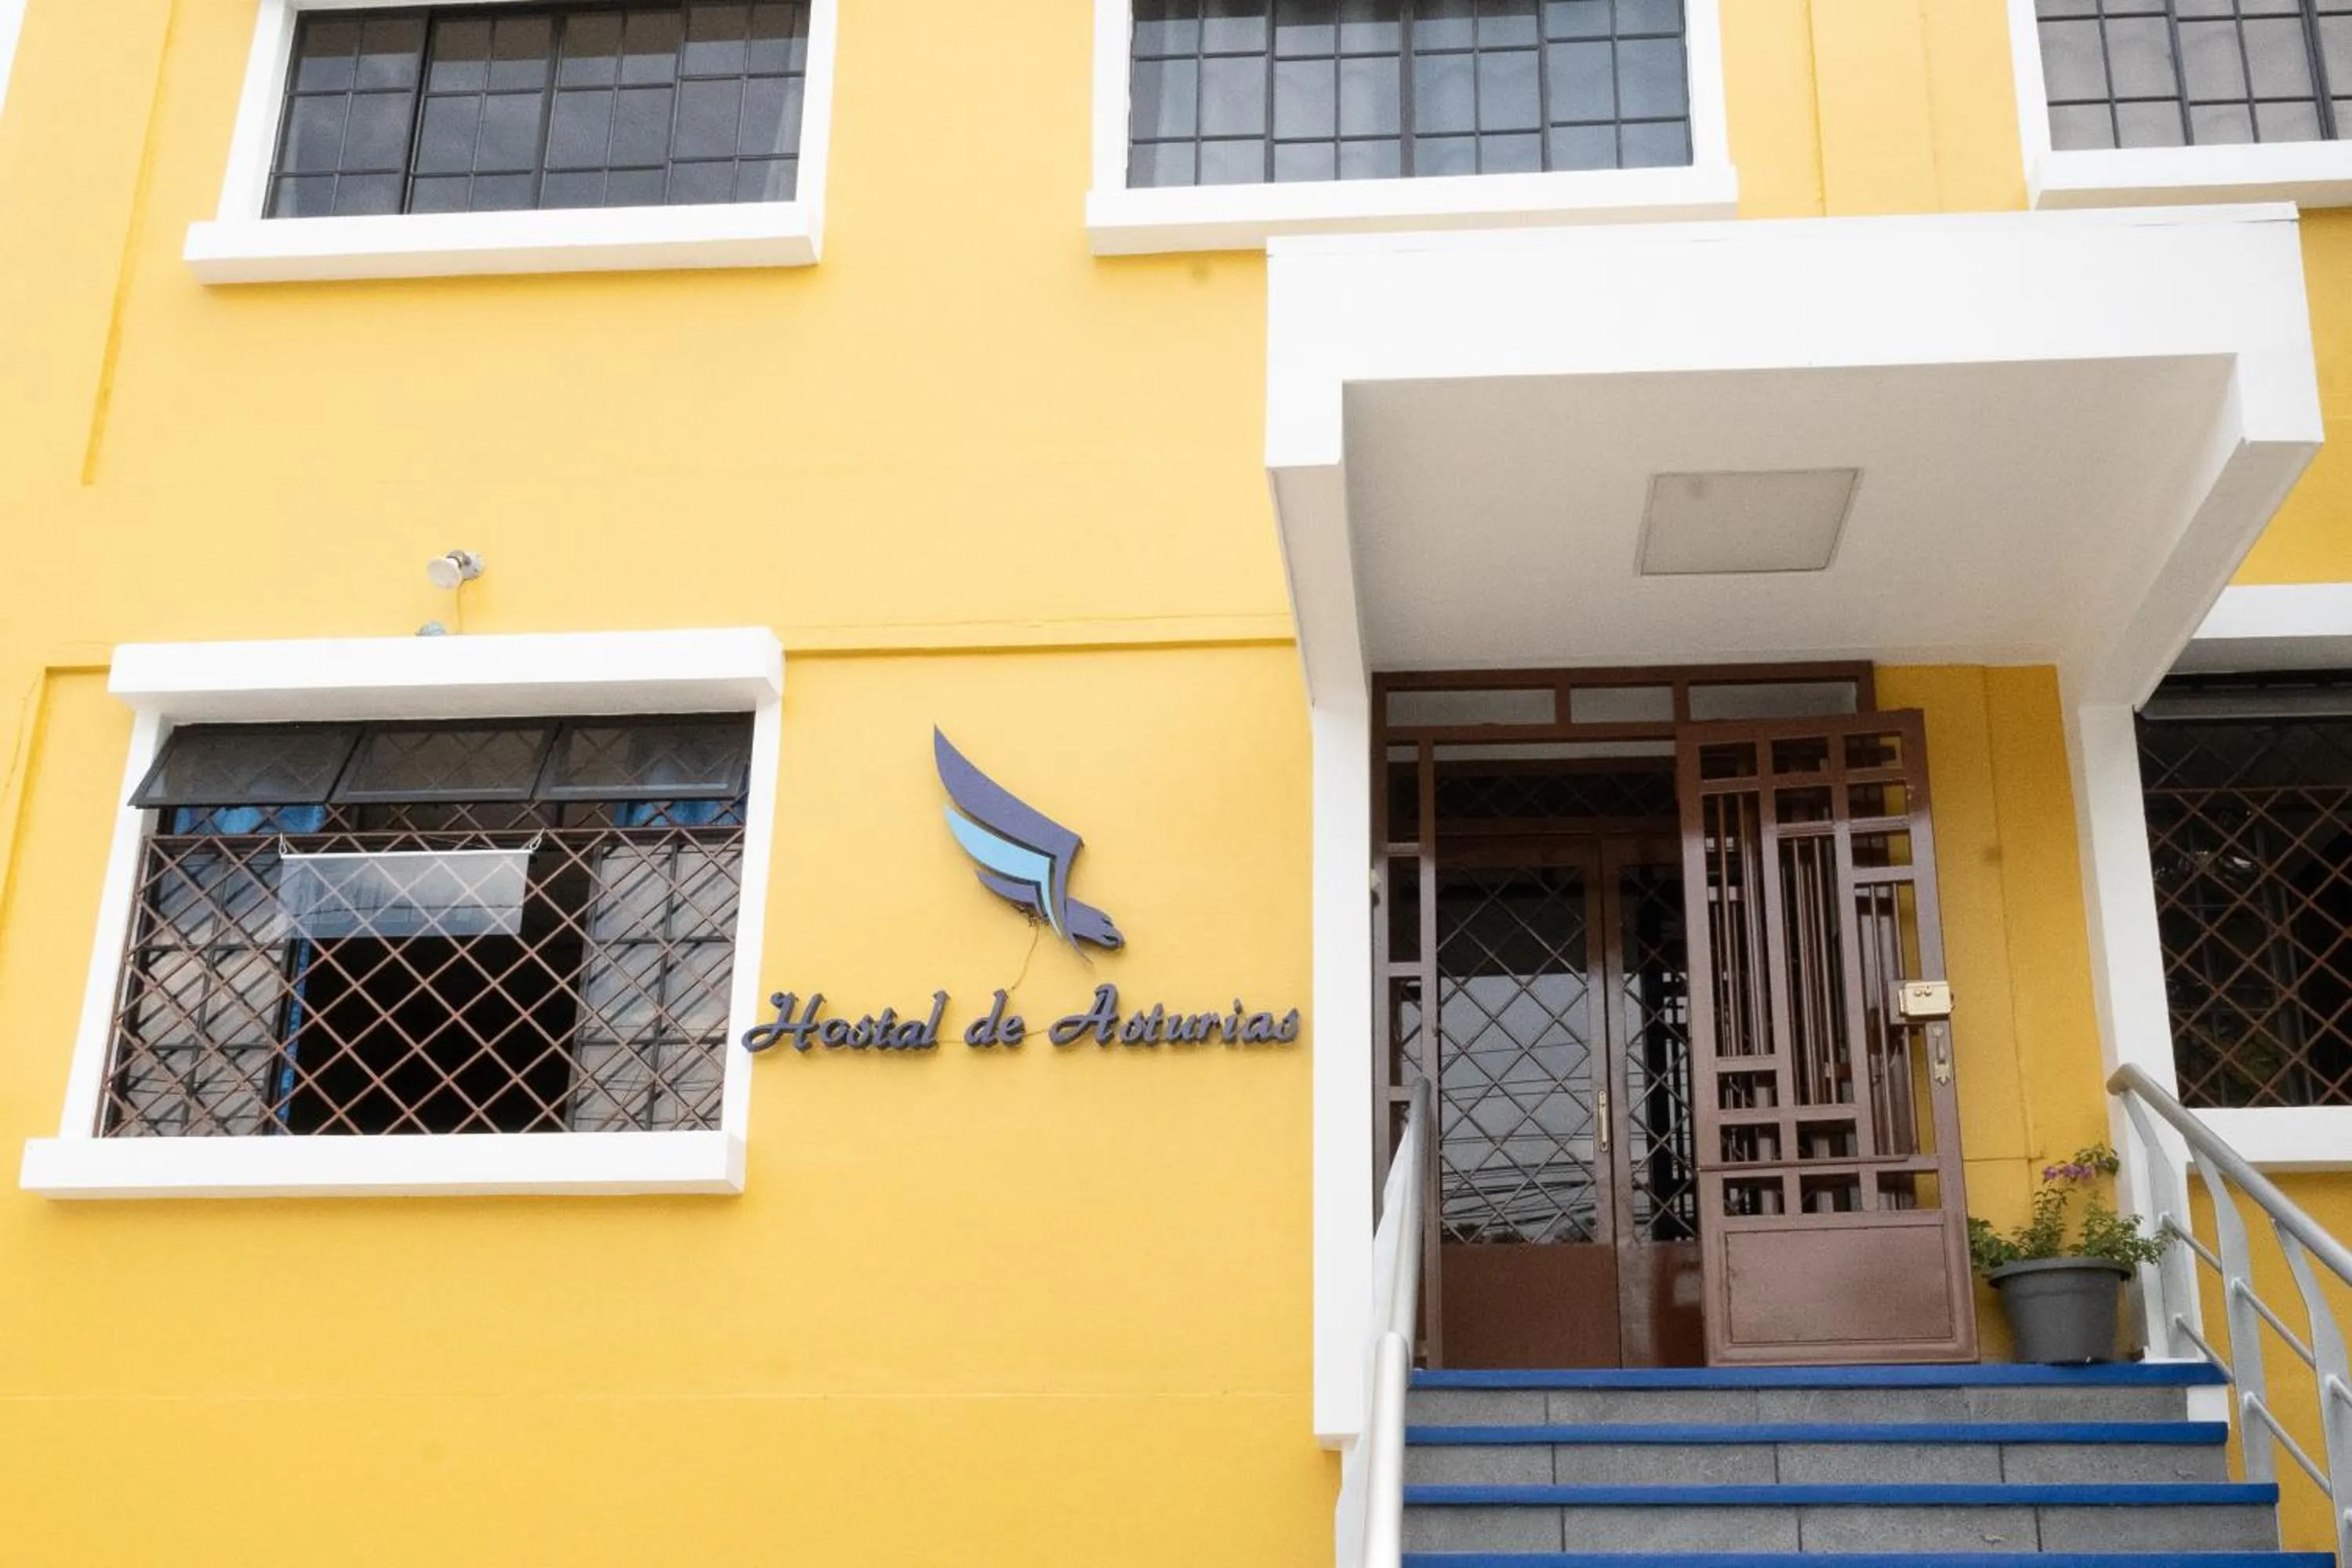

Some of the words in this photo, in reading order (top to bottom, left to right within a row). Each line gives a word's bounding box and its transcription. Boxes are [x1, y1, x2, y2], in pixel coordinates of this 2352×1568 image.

[742, 990, 951, 1053] Hostal
[964, 988, 1025, 1047] de
[1048, 983, 1300, 1047] Asturias
